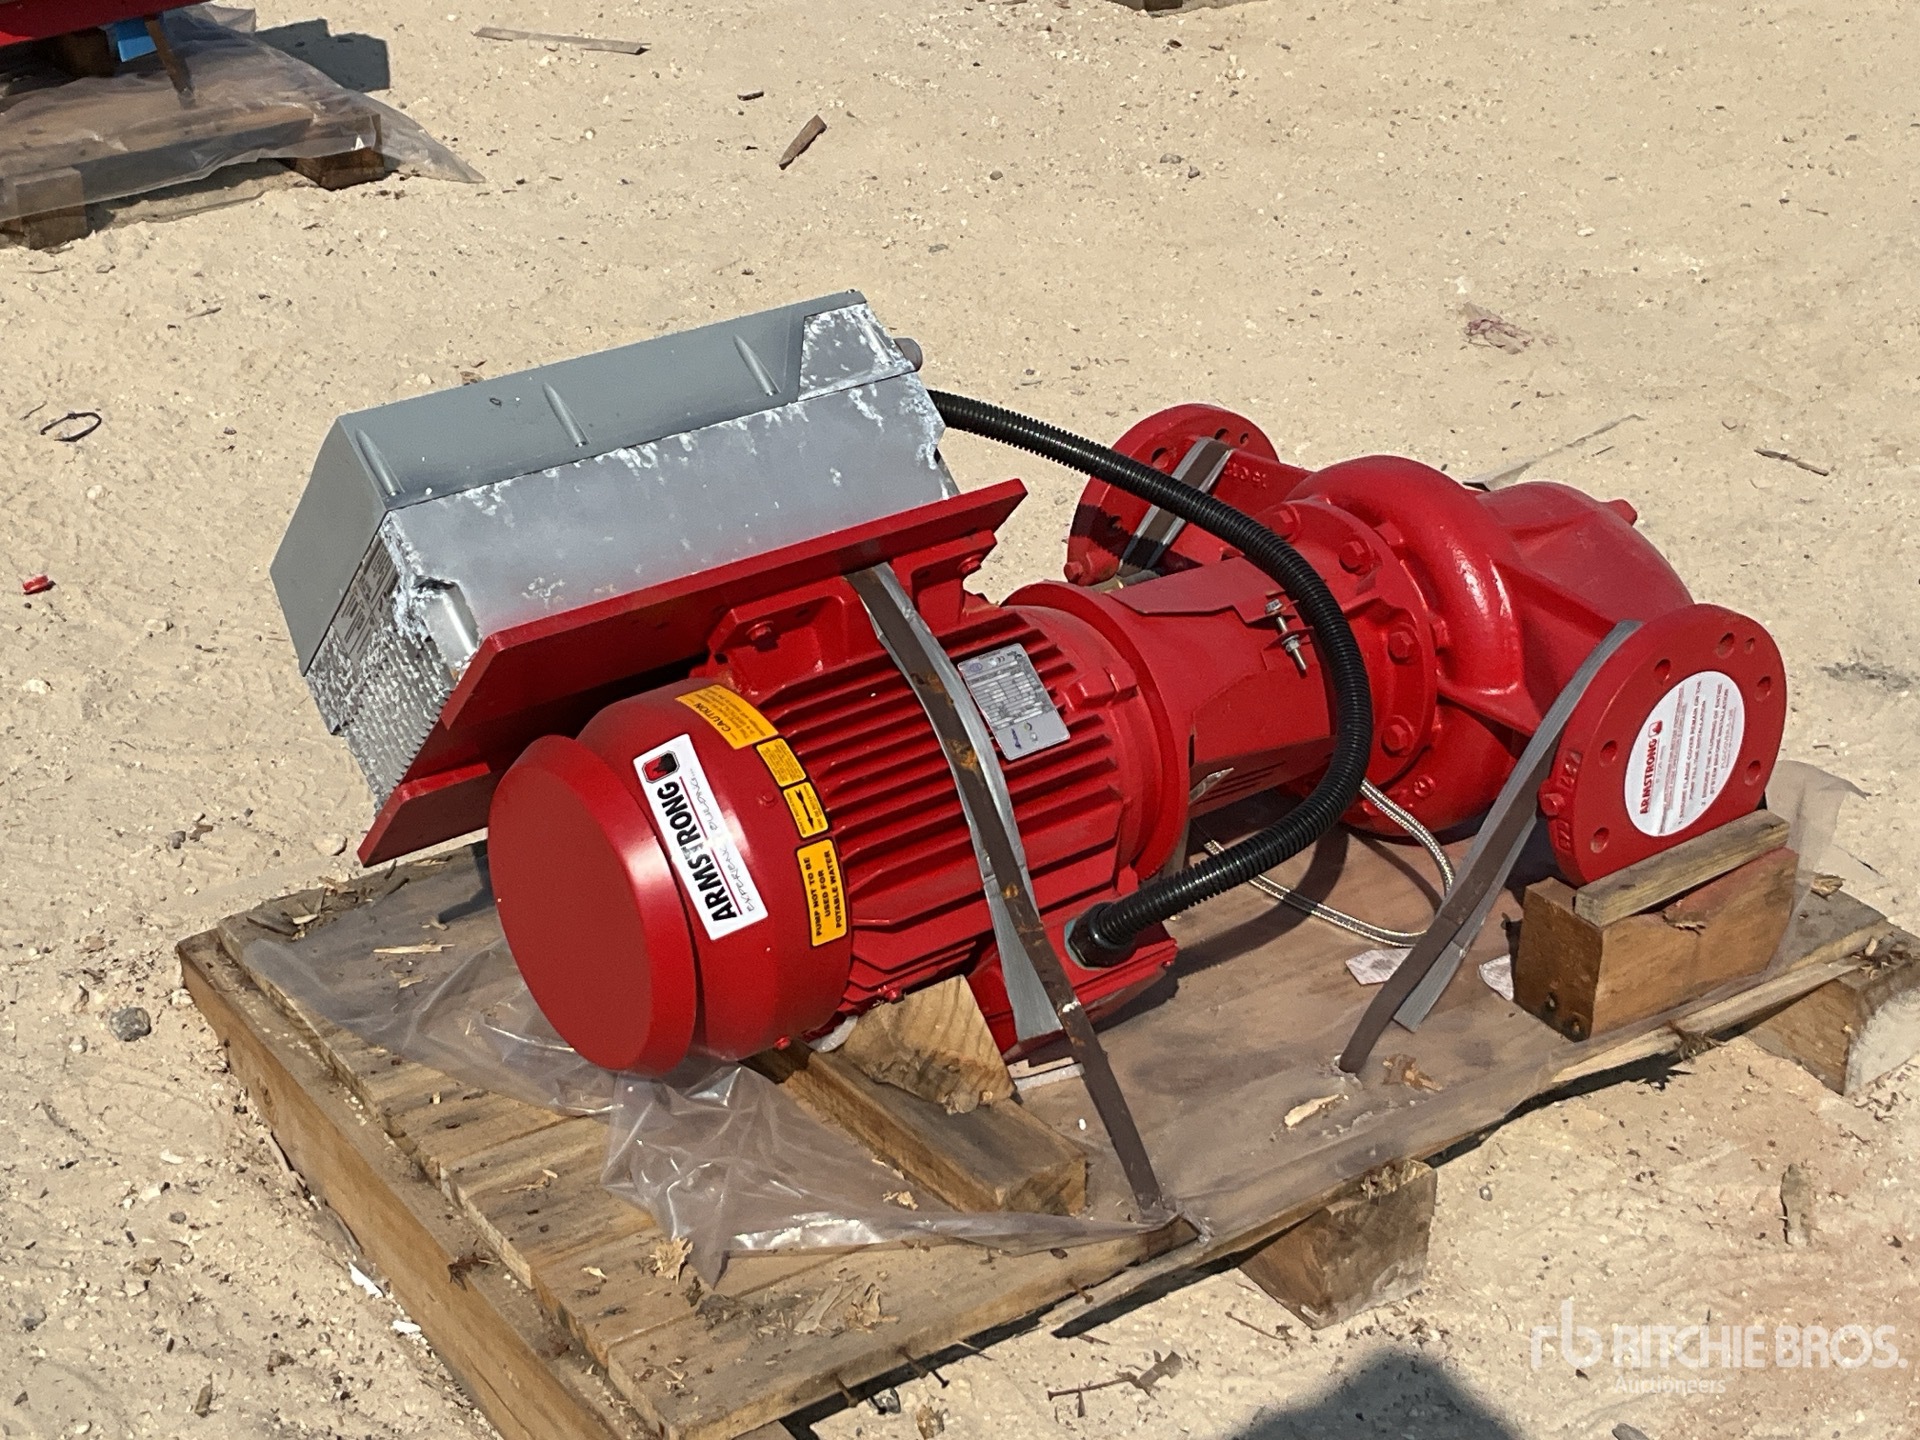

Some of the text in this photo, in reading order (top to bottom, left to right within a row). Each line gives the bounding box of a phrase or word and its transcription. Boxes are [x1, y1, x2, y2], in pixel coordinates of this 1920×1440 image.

[694, 702, 731, 732] CAUTION
[1639, 738, 1658, 815] ARMSTRONG
[657, 782, 737, 922] ARMSTRONG
[823, 850, 842, 928] POTABLE WATER
[803, 856, 822, 936] PUMP NOT TO BE
[817, 869, 830, 916] USED FOR
